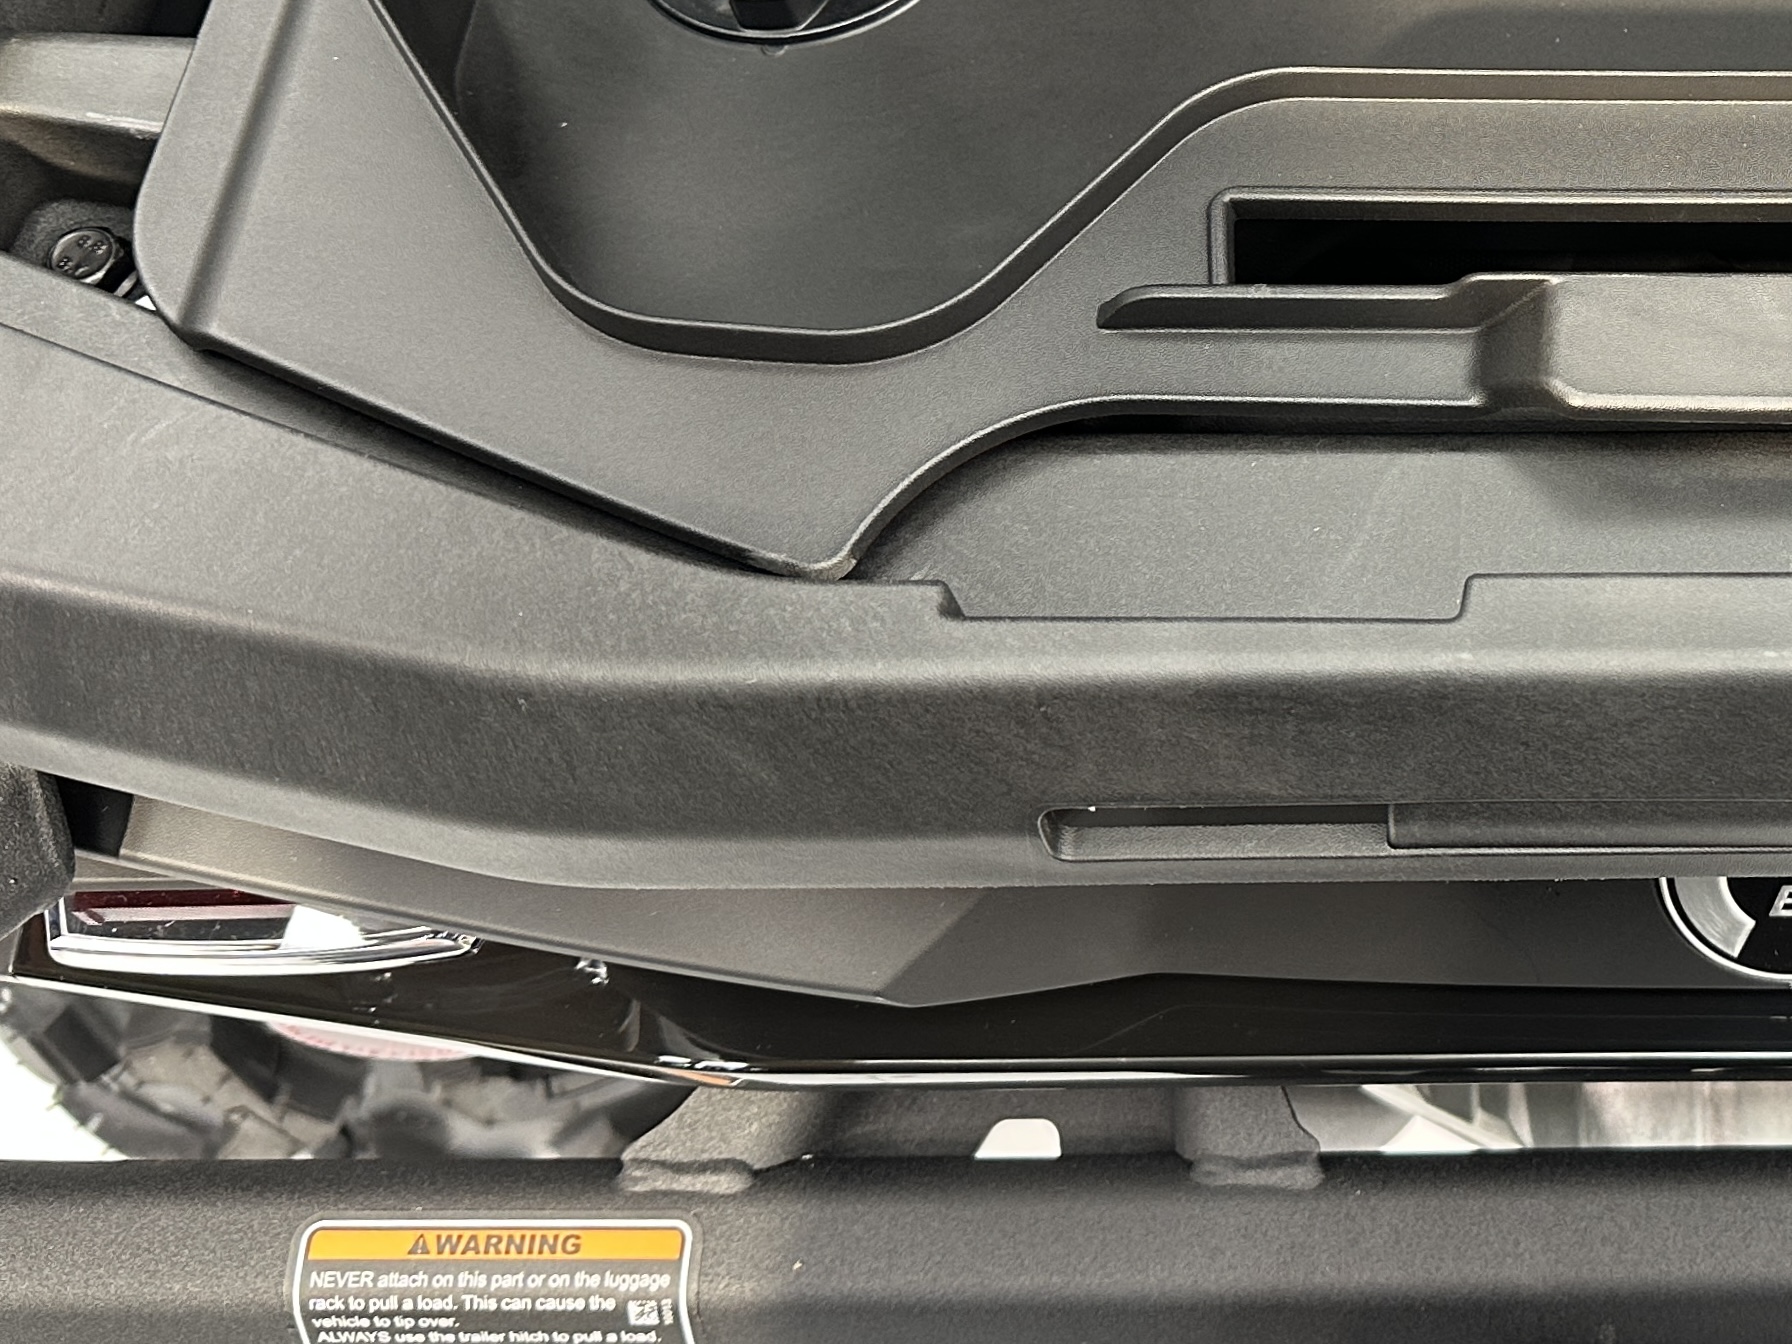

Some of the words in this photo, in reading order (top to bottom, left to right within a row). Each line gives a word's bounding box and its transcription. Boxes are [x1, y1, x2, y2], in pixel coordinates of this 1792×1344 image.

[435, 1233, 582, 1256] WARNING
[309, 1271, 374, 1288] NEVER
[377, 1271, 429, 1288] attach
[432, 1273, 453, 1288] on
[457, 1270, 488, 1288] this
[490, 1271, 525, 1291] part
[527, 1273, 546, 1288] or
[548, 1273, 570, 1288] on
[574, 1270, 601, 1288] the
[604, 1270, 671, 1292] luggage
[309, 1294, 345, 1311] rack
[347, 1296, 365, 1311] to
[369, 1294, 398, 1313] pull
[402, 1297, 413, 1311] a
[417, 1294, 458, 1311] load.
[461, 1294, 498, 1311] This
[501, 1297, 532, 1311] can
[535, 1297, 586, 1311] cause
[588, 1294, 616, 1311] the
[311, 1314, 371, 1328] vehicle
[373, 1315, 391, 1328] to
[393, 1314, 416, 1330] tip
[418, 1316, 461, 1328] over.
[317, 1331, 392, 1343] ALWAYS
[394, 1333, 425, 1343] use
[428, 1331, 456, 1343] the
[458, 1331, 506, 1343] trailer
[509, 1330, 550, 1343] hitch
[552, 1331, 570, 1343] to
[572, 1331, 602, 1344] pull
[606, 1333, 618, 1343] a
[620, 1330, 663, 1343] load.
